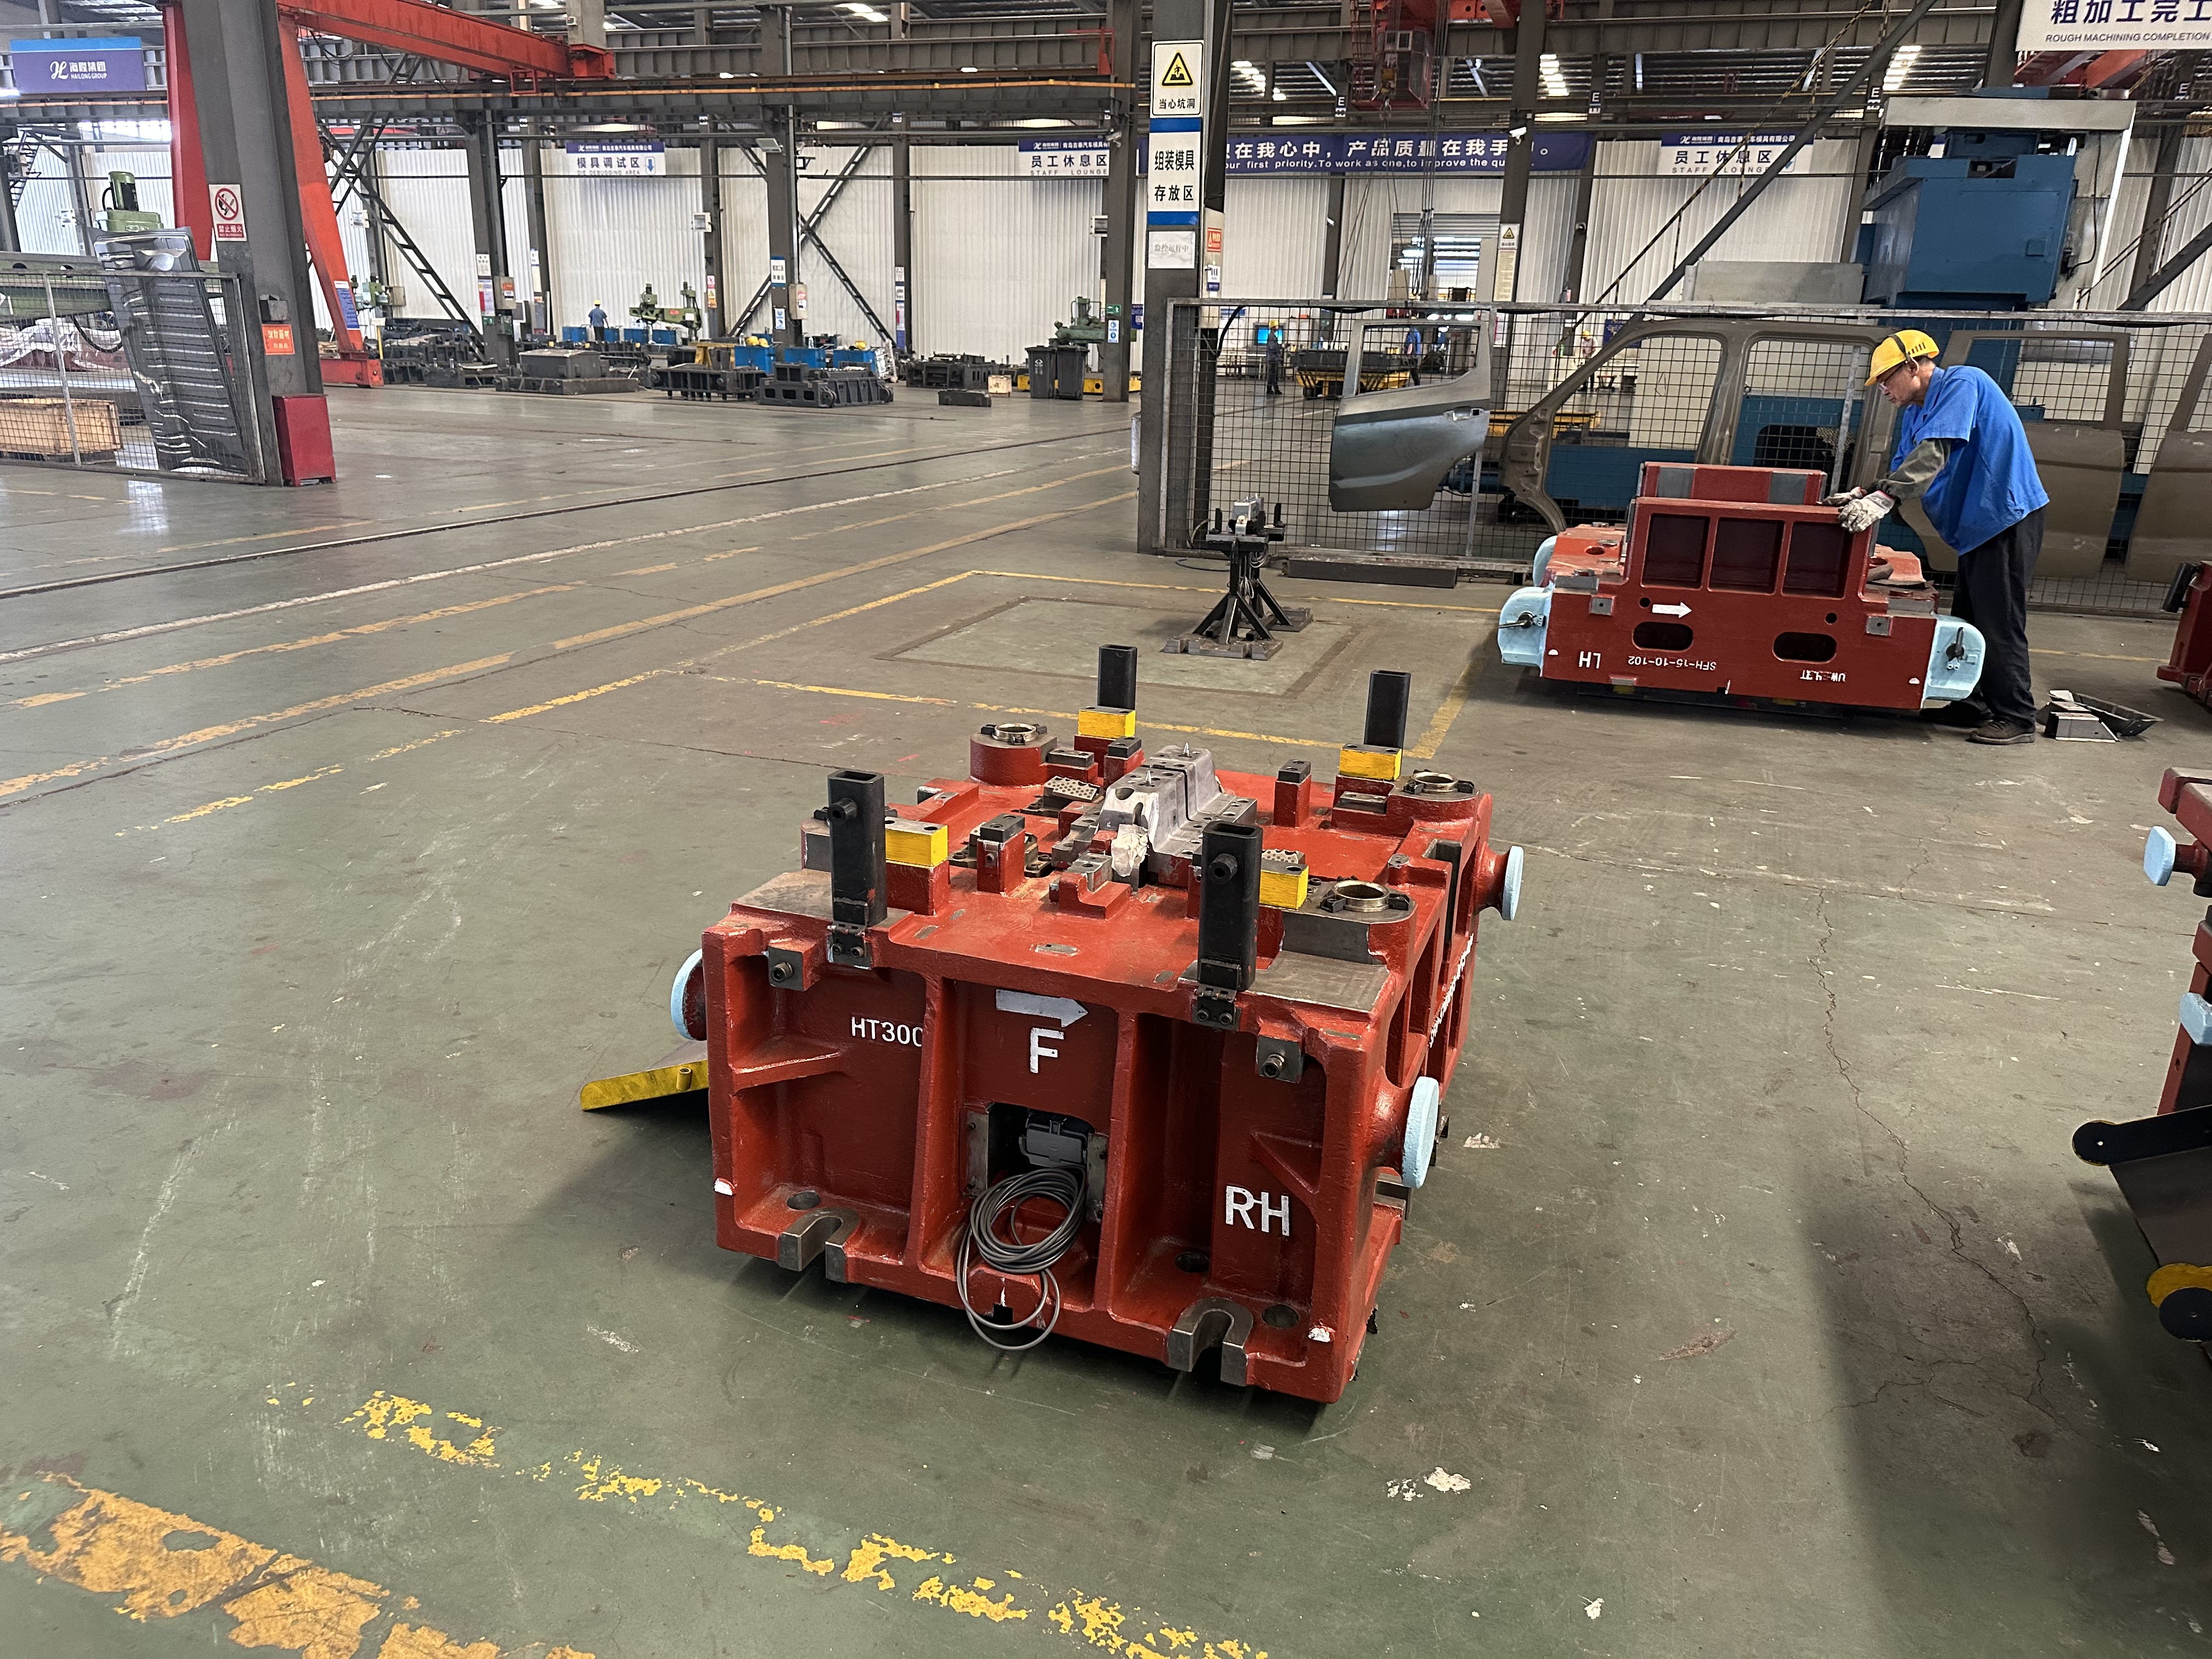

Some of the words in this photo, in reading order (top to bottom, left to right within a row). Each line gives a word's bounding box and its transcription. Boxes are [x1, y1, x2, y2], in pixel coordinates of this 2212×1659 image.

[2045, 34, 2081, 42] ROUGH
[2083, 33, 2141, 42] MACHINING
[2143, 32, 2210, 41] COMPLETION
[1592, 92, 1600, 101] E
[1871, 87, 1880, 97] E
[1159, 98, 1195, 109] 当心坑洞
[1338, 97, 1345, 106] E
[577, 157, 640, 168] 模具调试区
[1031, 154, 1107, 168] 员工休息区
[1154, 150, 1194, 171] 组装模具
[1470, 158, 1488, 166] the
[1675, 150, 1772, 164] 员工休息区
[1154, 184, 1194, 202] 存放区
[1154, 244, 1189, 253] 监控运行中
[1578, 651, 1601, 669] LH
[1628, 655, 1717, 670] SFH-15-10-102
[851, 1016, 923, 1047] HT300
[1030, 1028, 1064, 1074] F
[1226, 1186, 1289, 1237] RH
